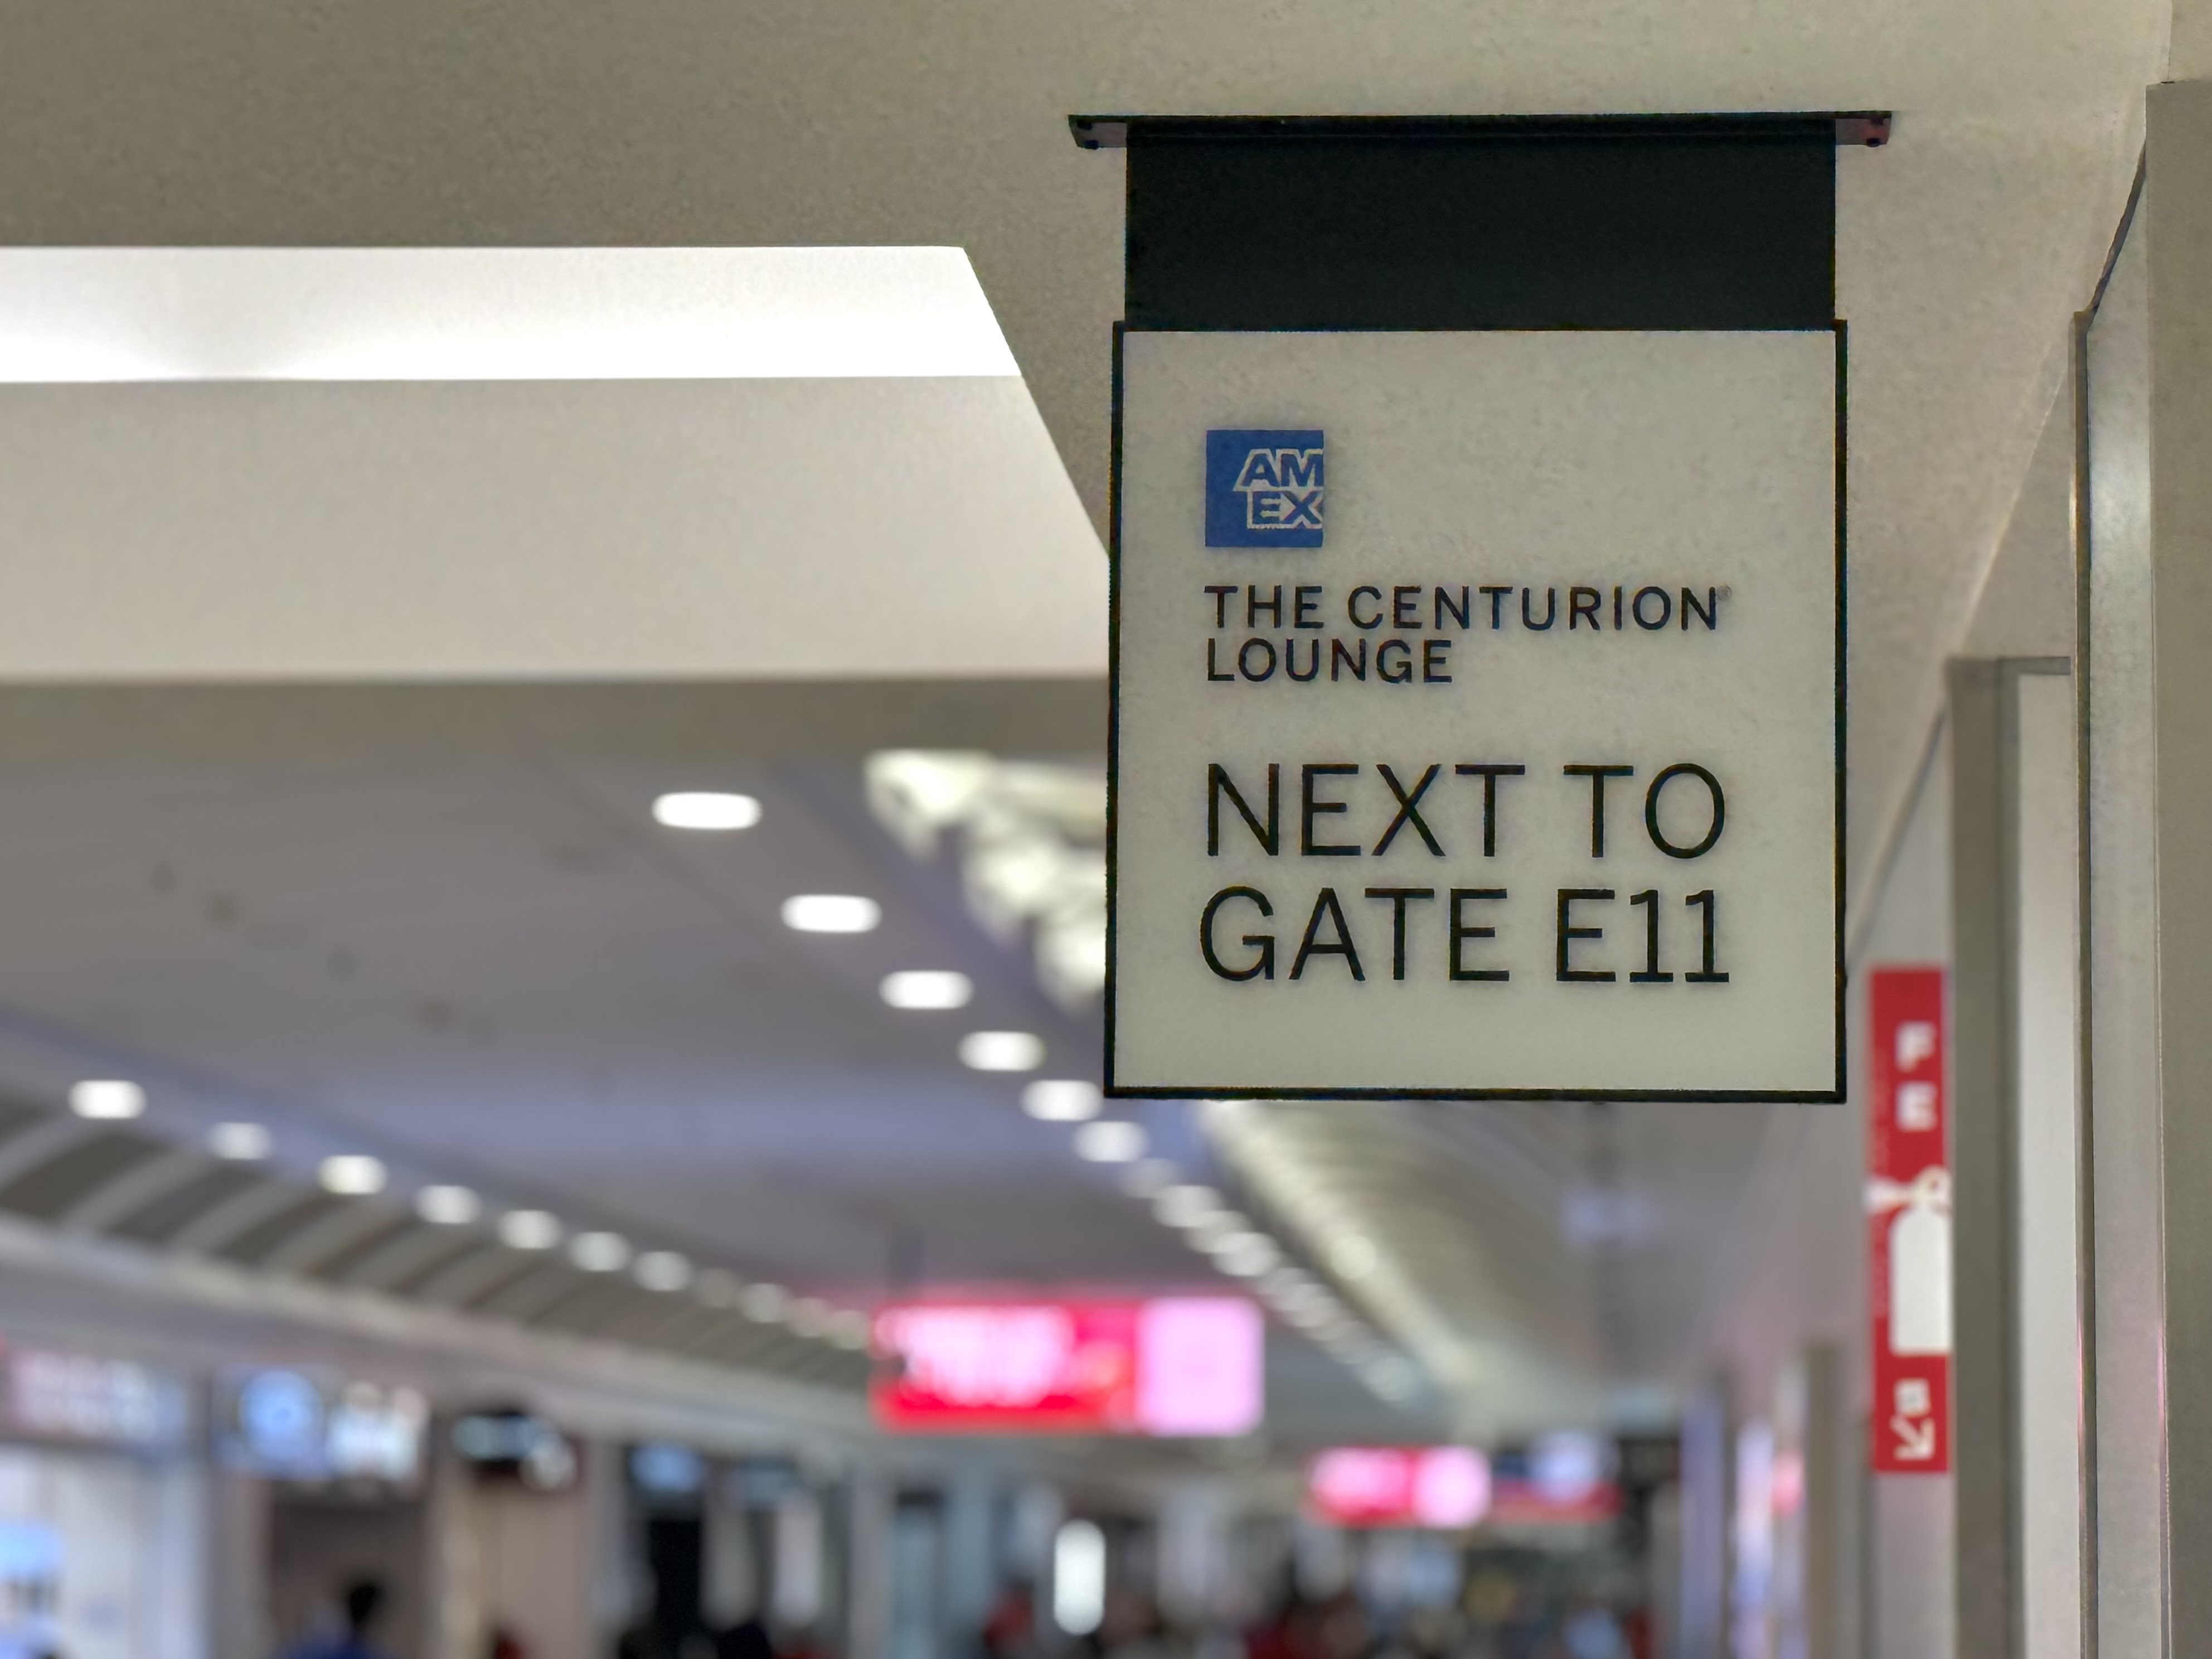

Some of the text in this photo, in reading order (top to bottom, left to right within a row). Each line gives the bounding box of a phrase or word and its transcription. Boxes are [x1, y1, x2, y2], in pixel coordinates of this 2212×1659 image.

[1204, 584, 1325, 630] THE
[1207, 637, 1453, 685] LOUNGE
[1207, 763, 1725, 860] NEXT TO
[1200, 885, 1730, 983] GATE E11
